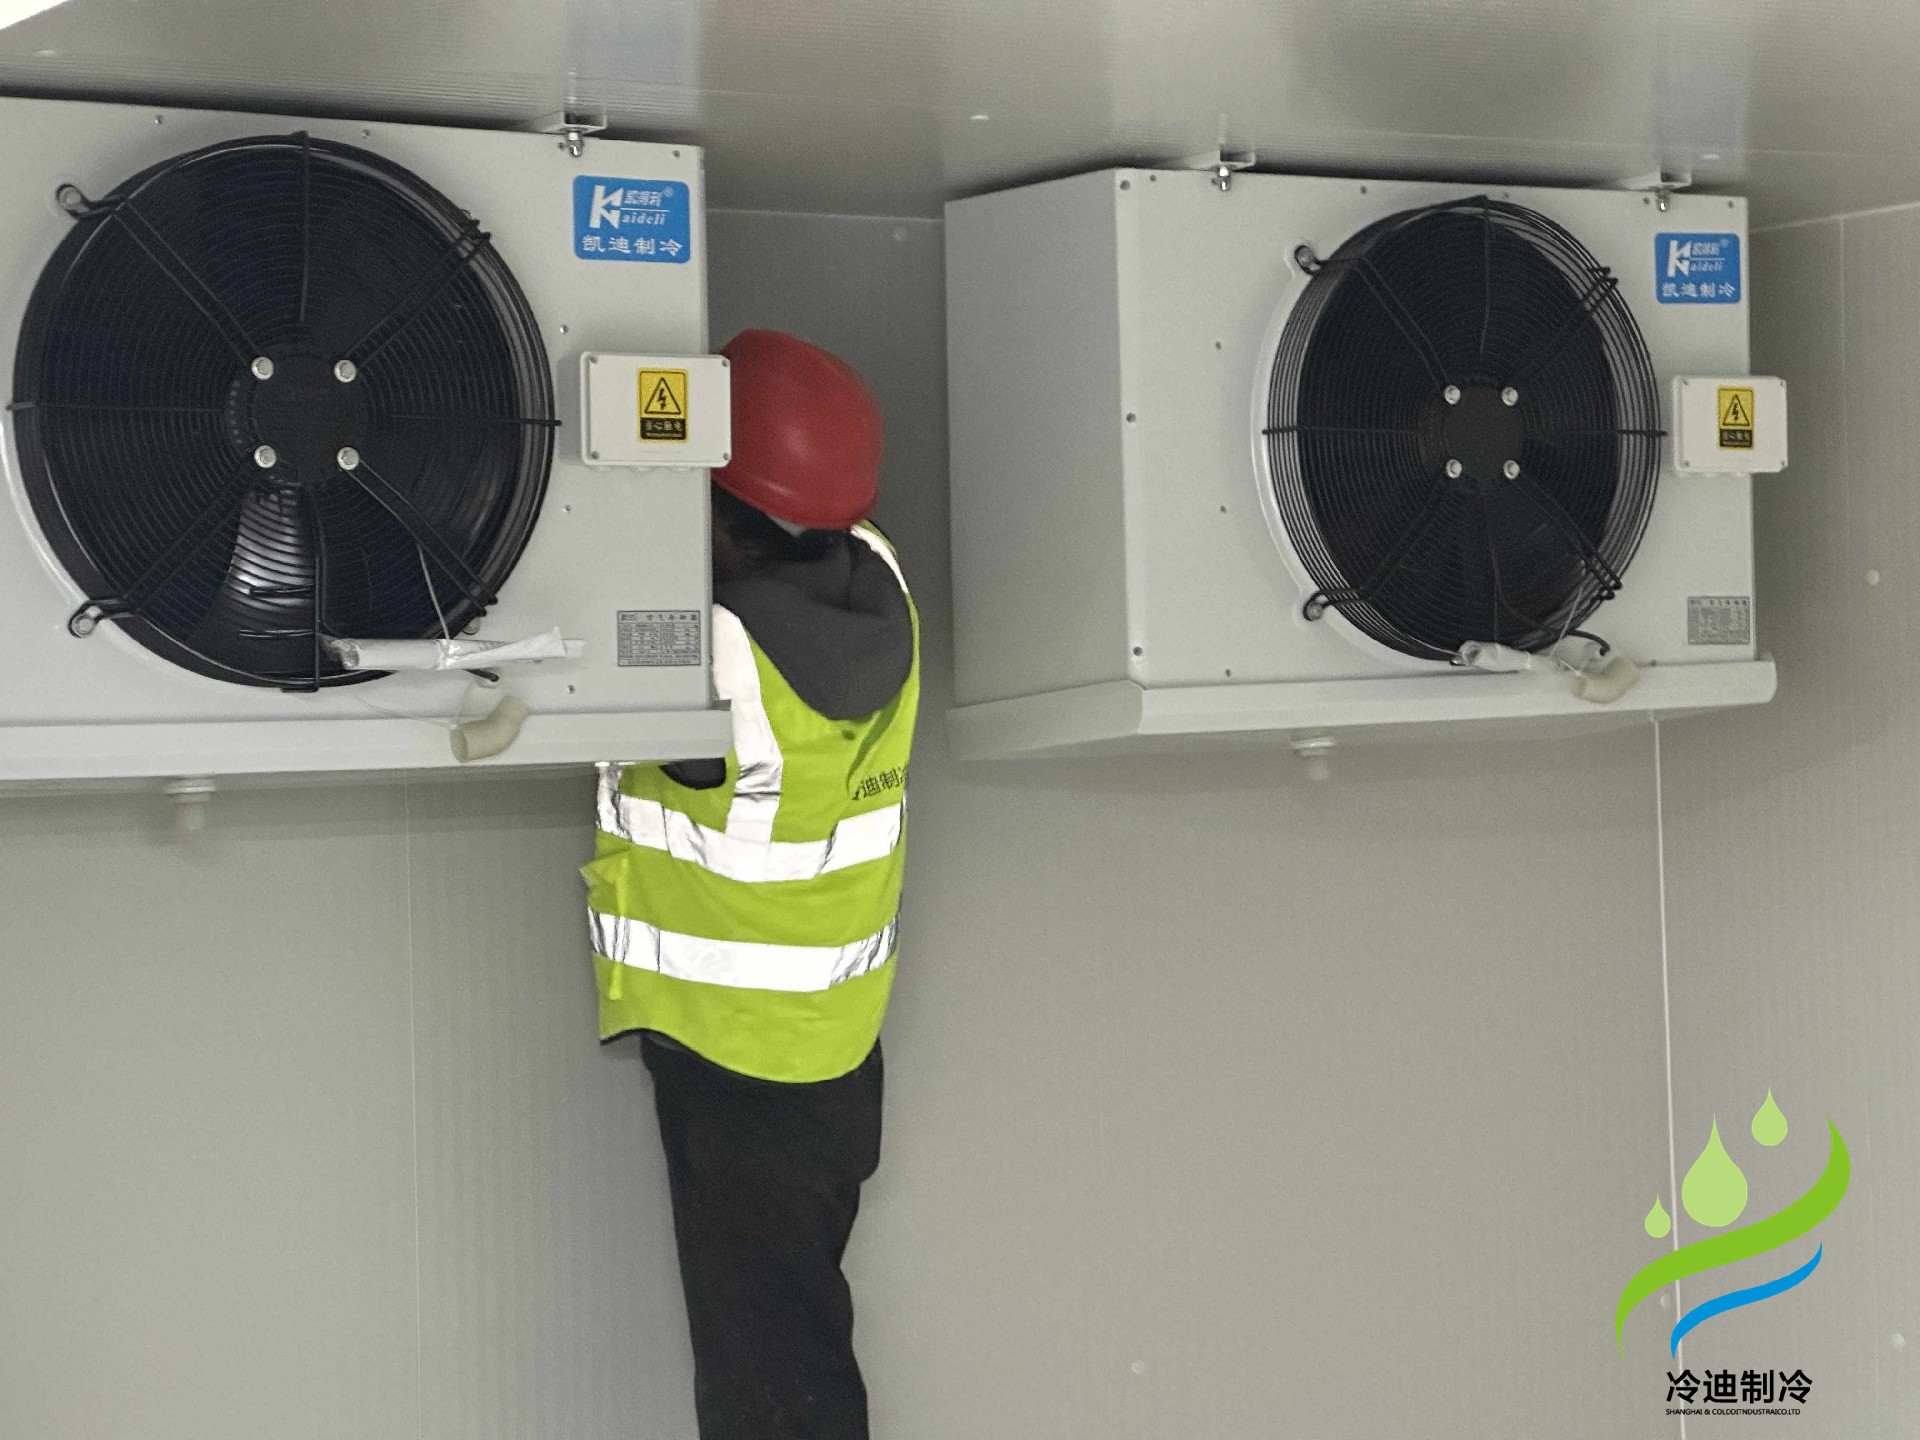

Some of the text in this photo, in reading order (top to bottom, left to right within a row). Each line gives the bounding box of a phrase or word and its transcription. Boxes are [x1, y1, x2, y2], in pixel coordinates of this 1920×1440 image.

[582, 235, 683, 257] 凯迪制冷
[851, 764, 908, 801] 迪制
